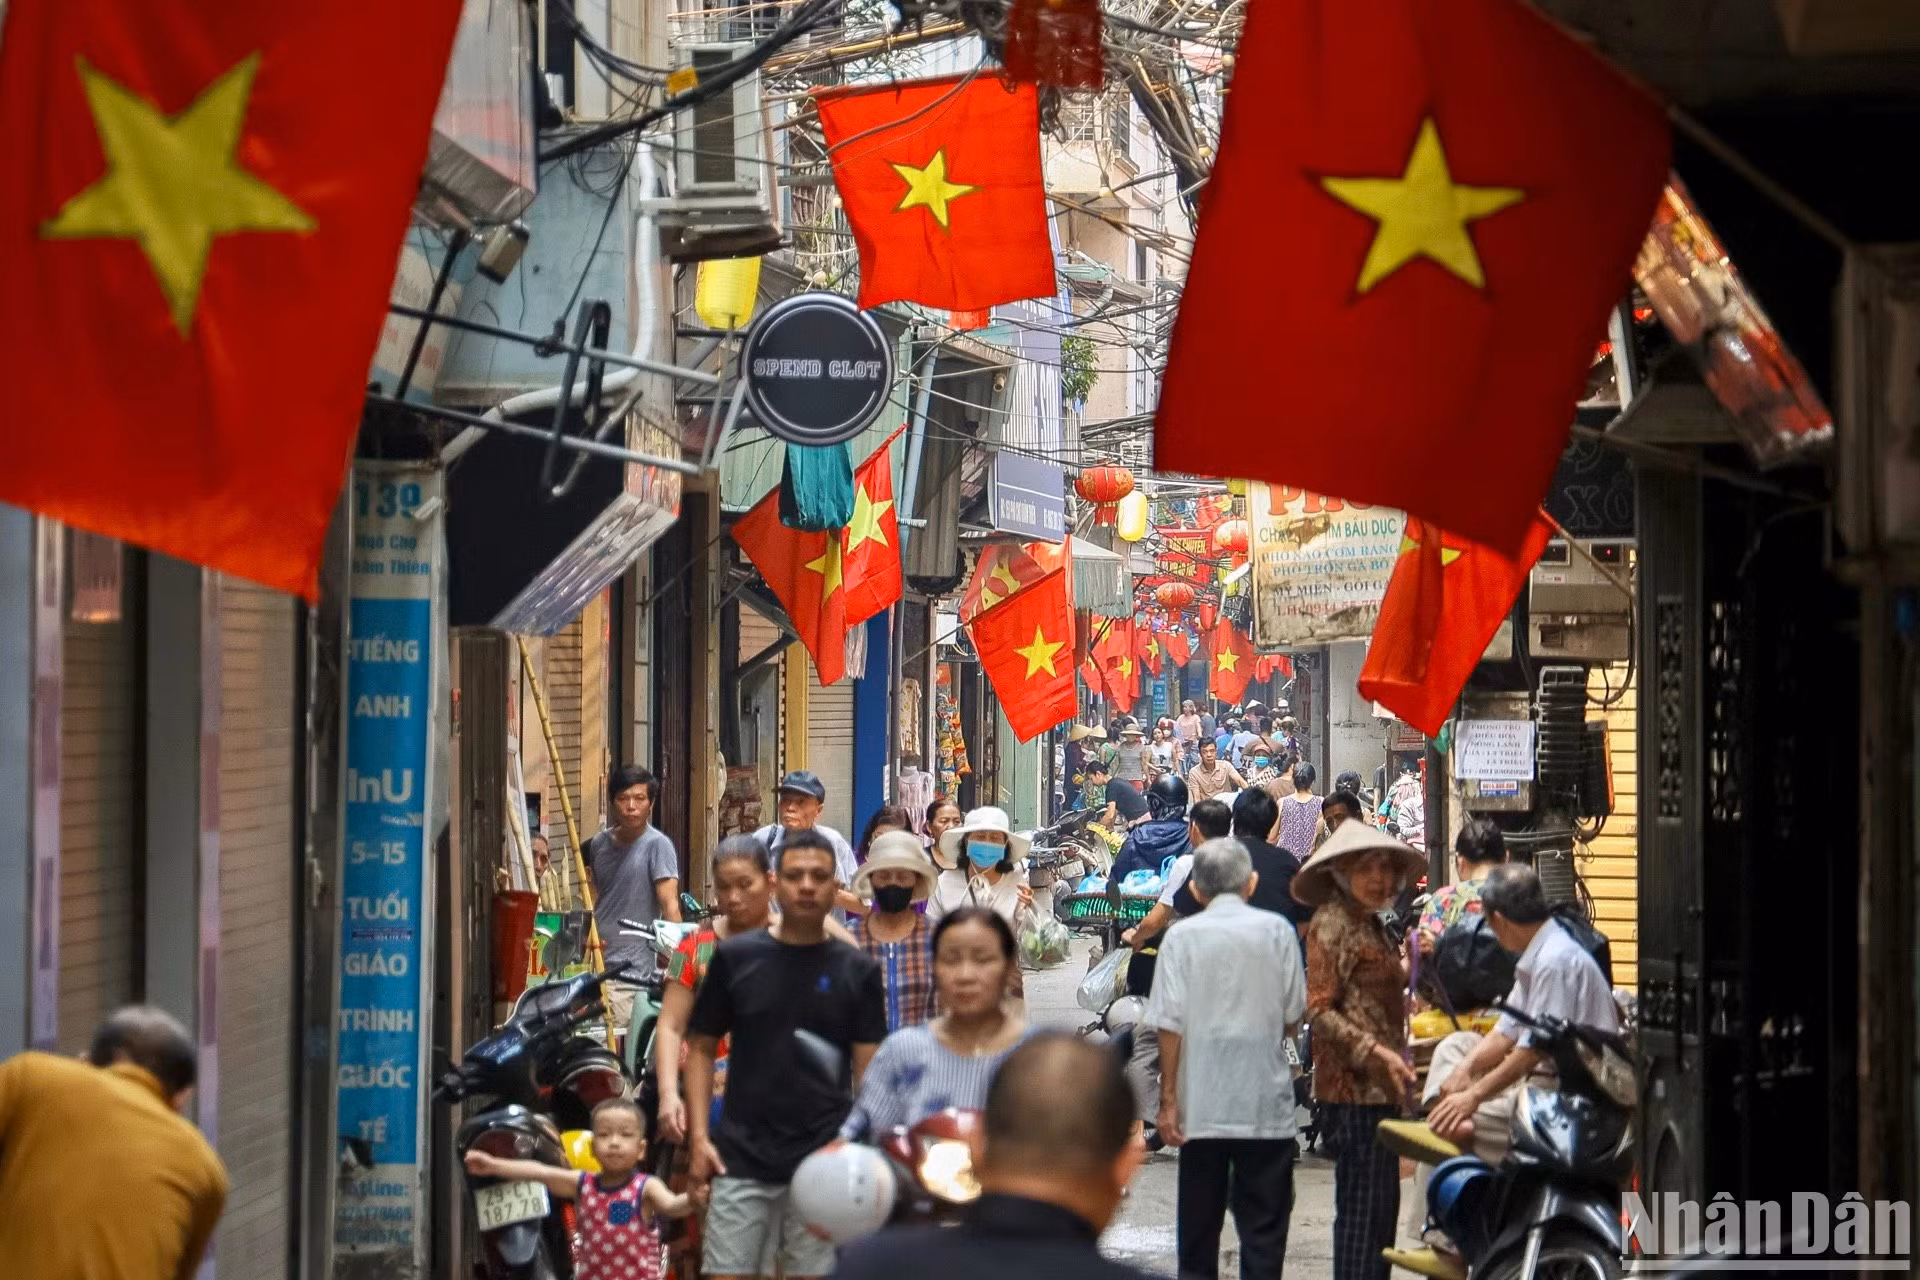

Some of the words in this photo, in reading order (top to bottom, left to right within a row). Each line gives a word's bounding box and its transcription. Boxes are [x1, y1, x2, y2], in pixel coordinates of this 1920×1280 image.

[753, 358, 821, 377] SPEND
[829, 360, 880, 378] CLOT
[355, 695, 412, 717] ANH
[344, 948, 408, 976] GIÁO
[338, 1004, 414, 1032] TRÌNH
[338, 1059, 411, 1088] QUỐC
